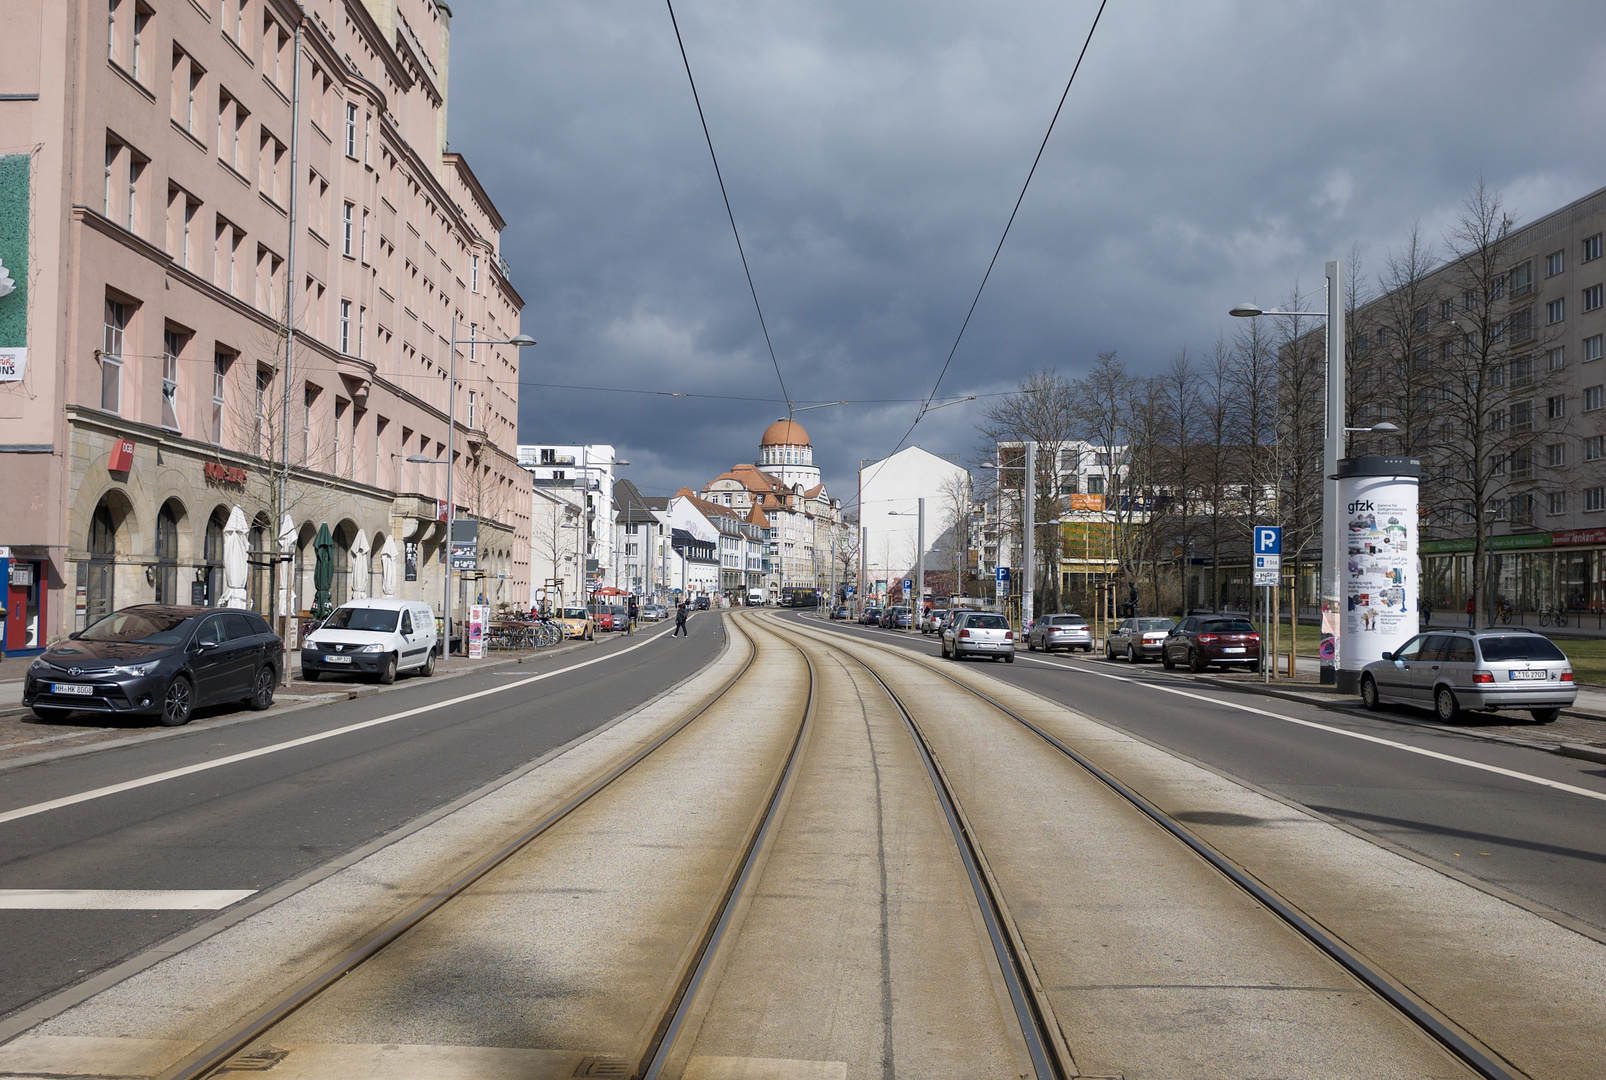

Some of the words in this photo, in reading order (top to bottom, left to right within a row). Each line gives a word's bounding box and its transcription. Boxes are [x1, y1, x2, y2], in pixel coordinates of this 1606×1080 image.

[122, 442, 133, 454] DGB
[1348, 500, 1374, 514] gfzk
[1261, 530, 1276, 551] P
[1571, 533, 1594, 543] lenken
[1000, 568, 1006, 579] P
